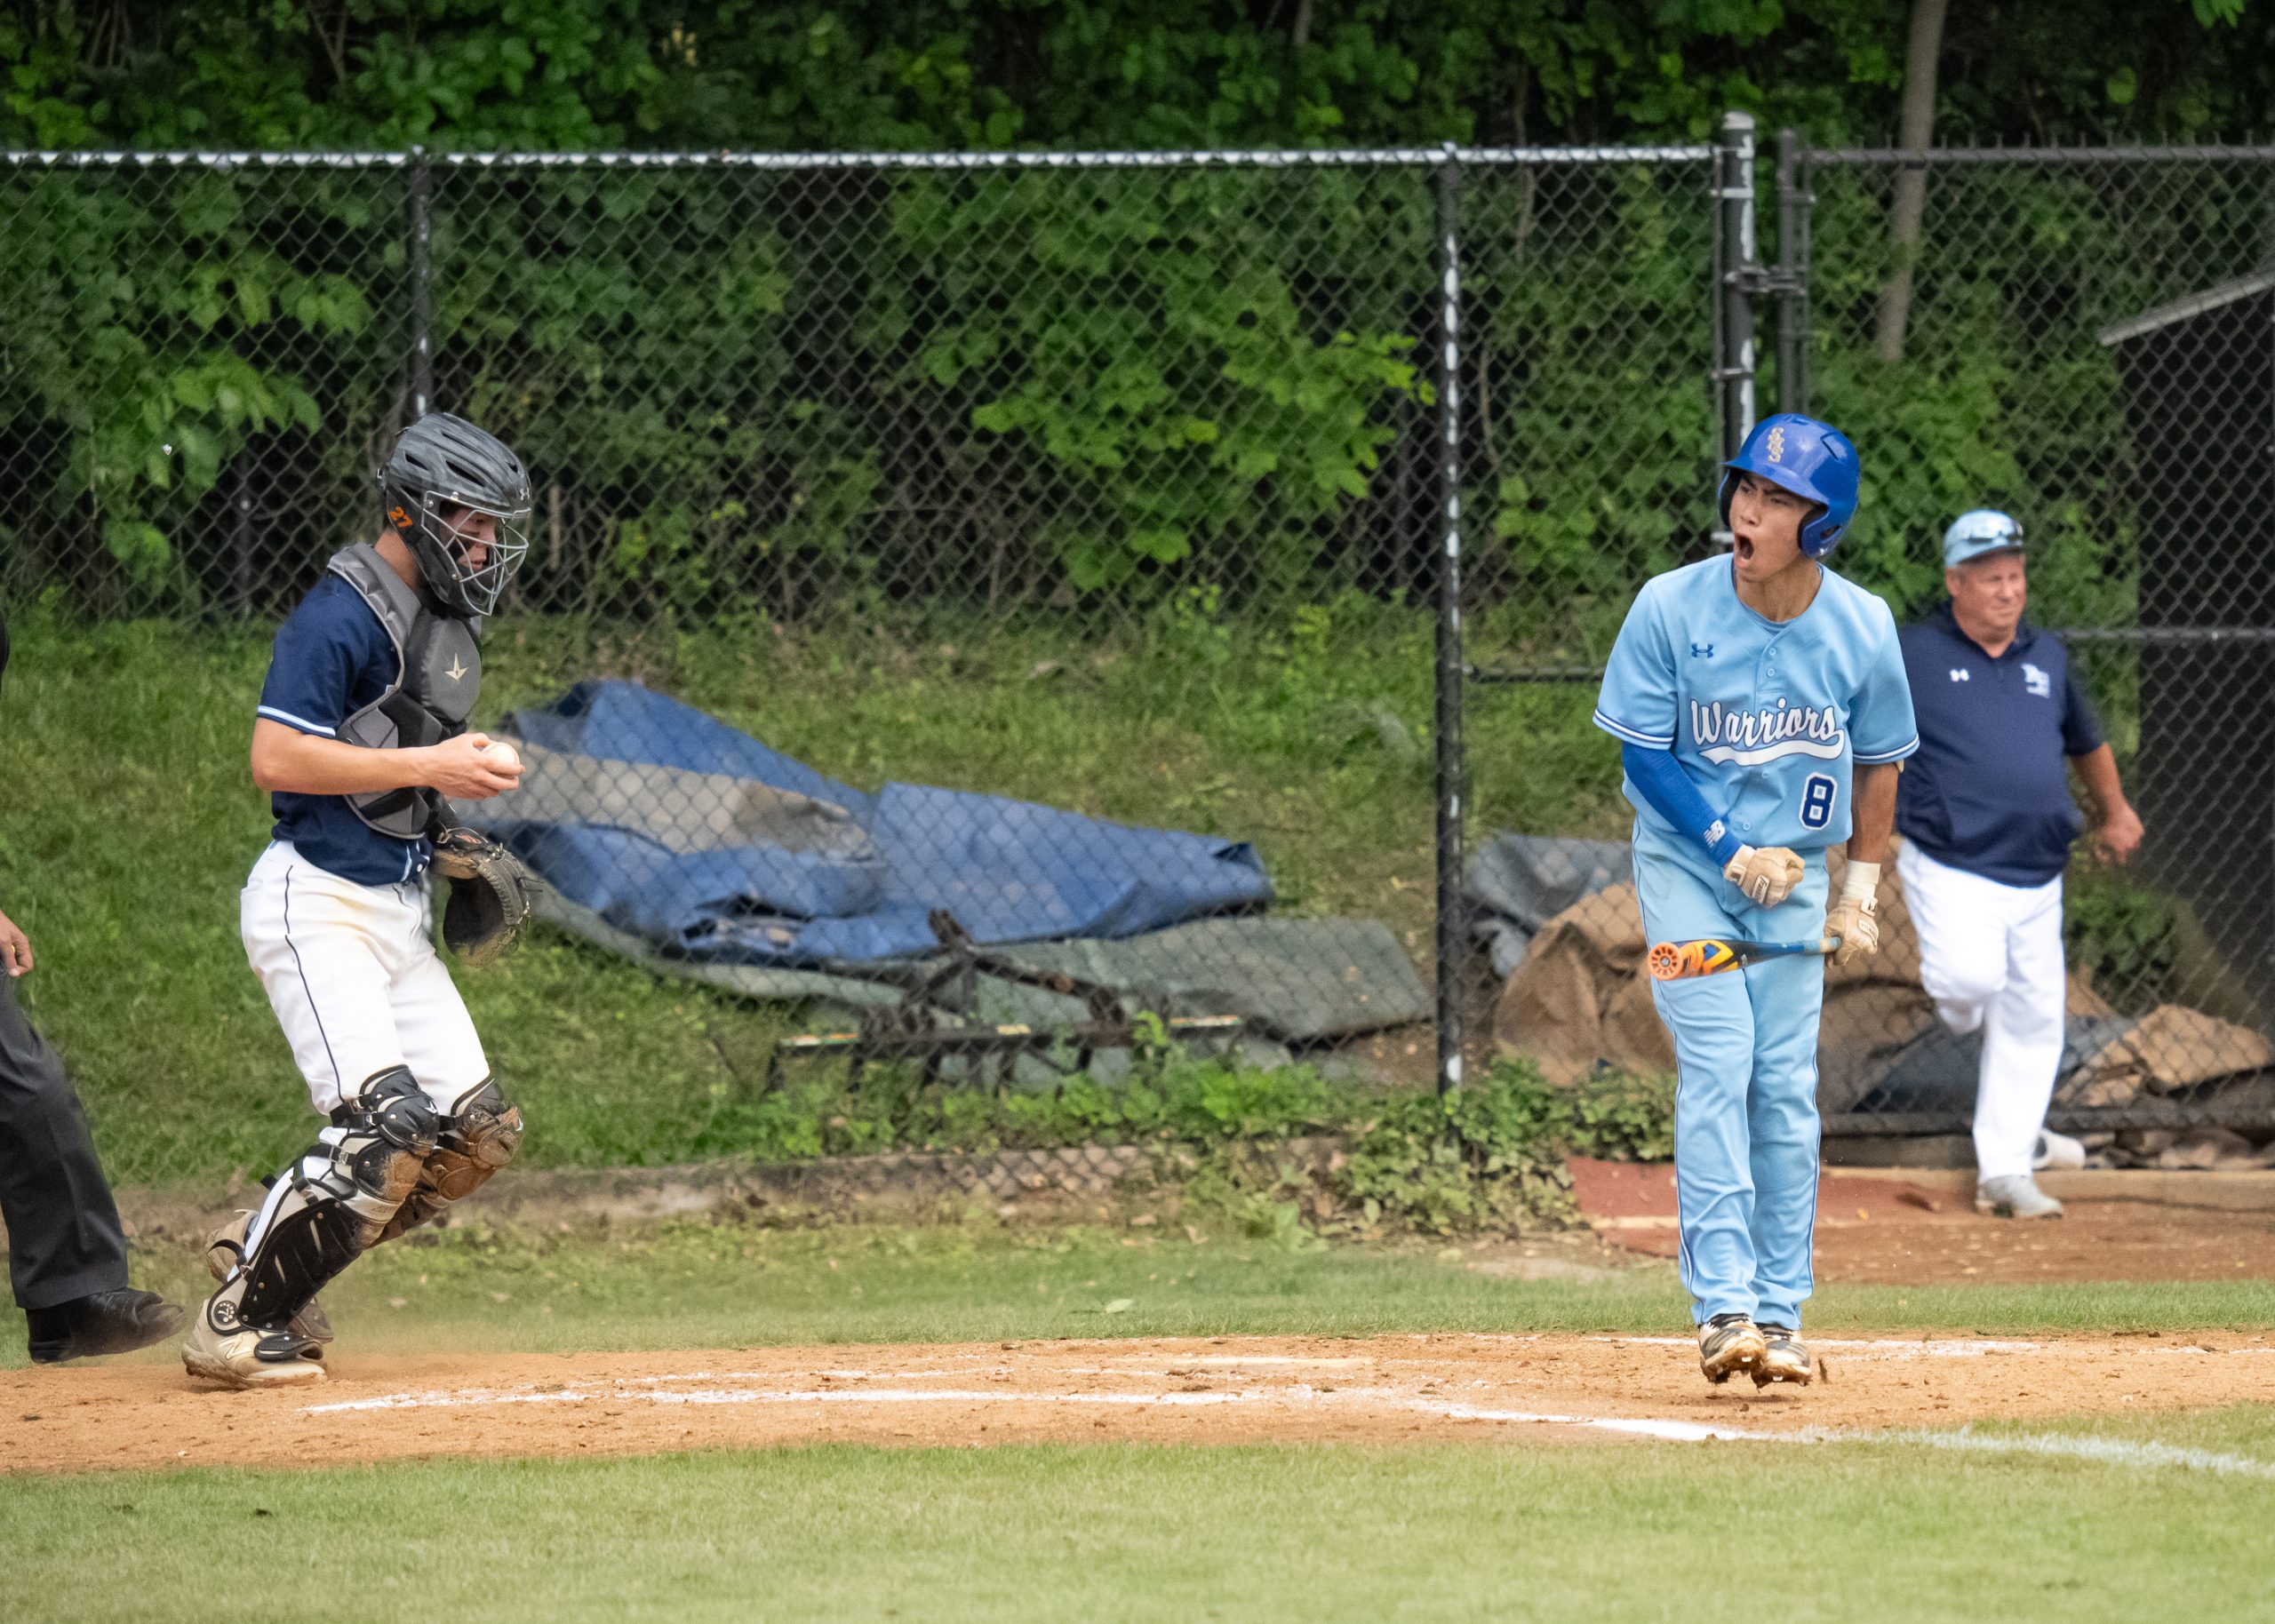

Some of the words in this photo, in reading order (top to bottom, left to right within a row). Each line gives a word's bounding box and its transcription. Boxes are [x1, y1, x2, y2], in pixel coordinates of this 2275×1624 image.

[389, 506, 413, 527] 27
[1690, 697, 1838, 748] Warriors
[1800, 772, 1838, 831] 8
